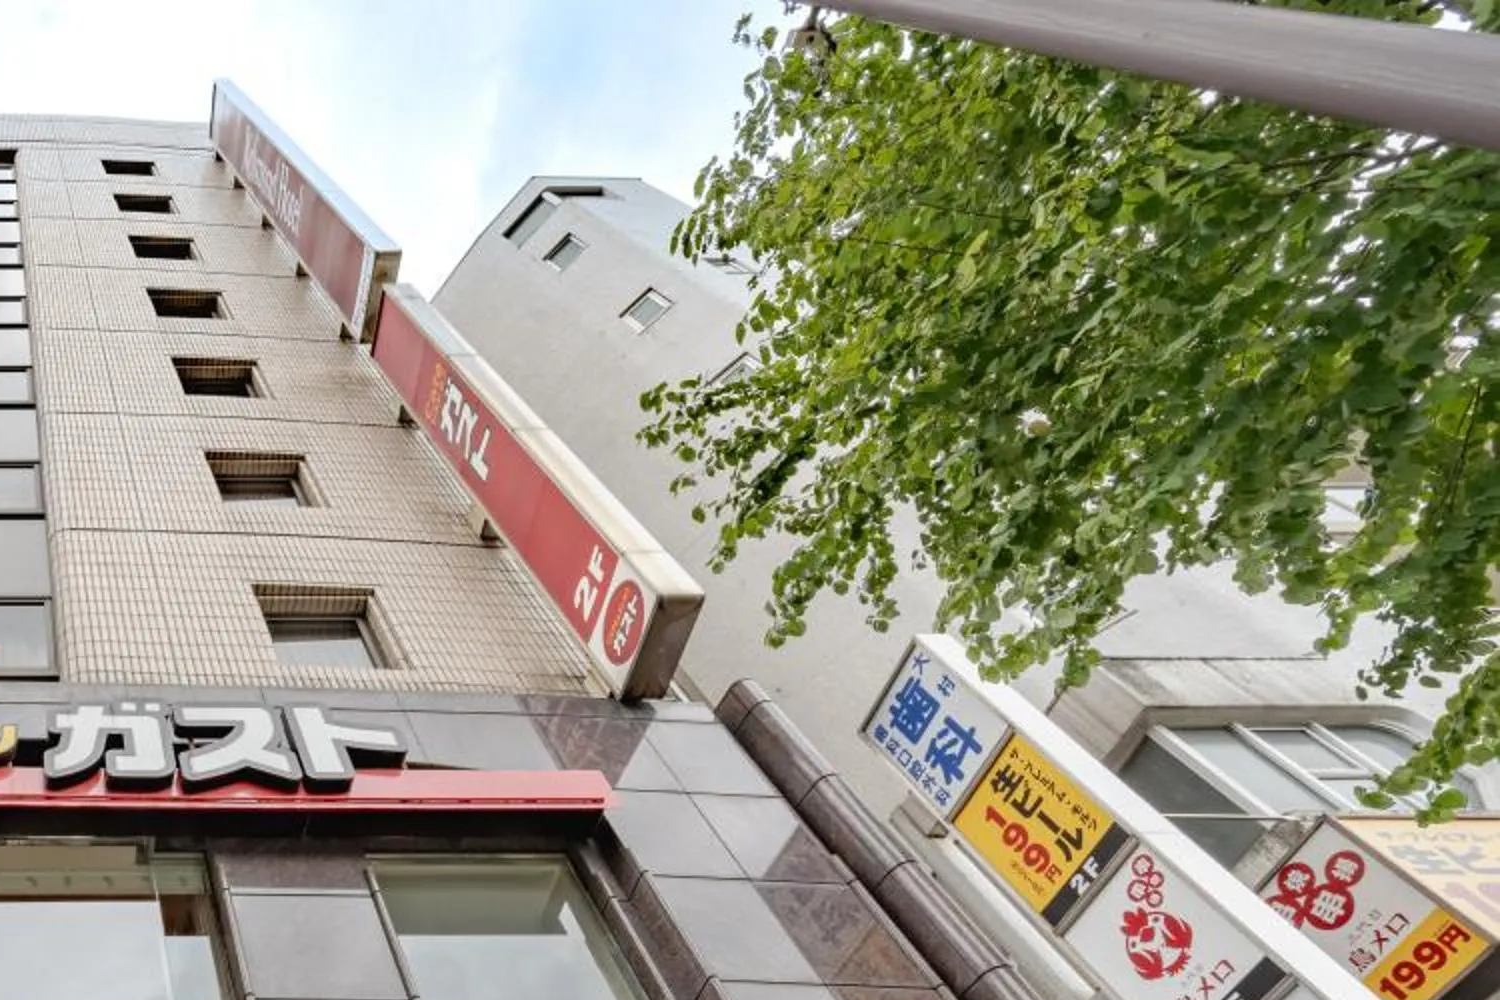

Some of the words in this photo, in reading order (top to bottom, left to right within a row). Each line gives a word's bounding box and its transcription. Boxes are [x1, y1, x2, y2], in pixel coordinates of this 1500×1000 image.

[574, 544, 605, 622] 2F
[47, 702, 407, 789] ガスト
[889, 676, 983, 785] 歯科
[985, 805, 1062, 884] 199円
[990, 764, 1083, 862] 生ビール
[1070, 856, 1100, 894] 2F
[1379, 923, 1471, 1000] 199円
